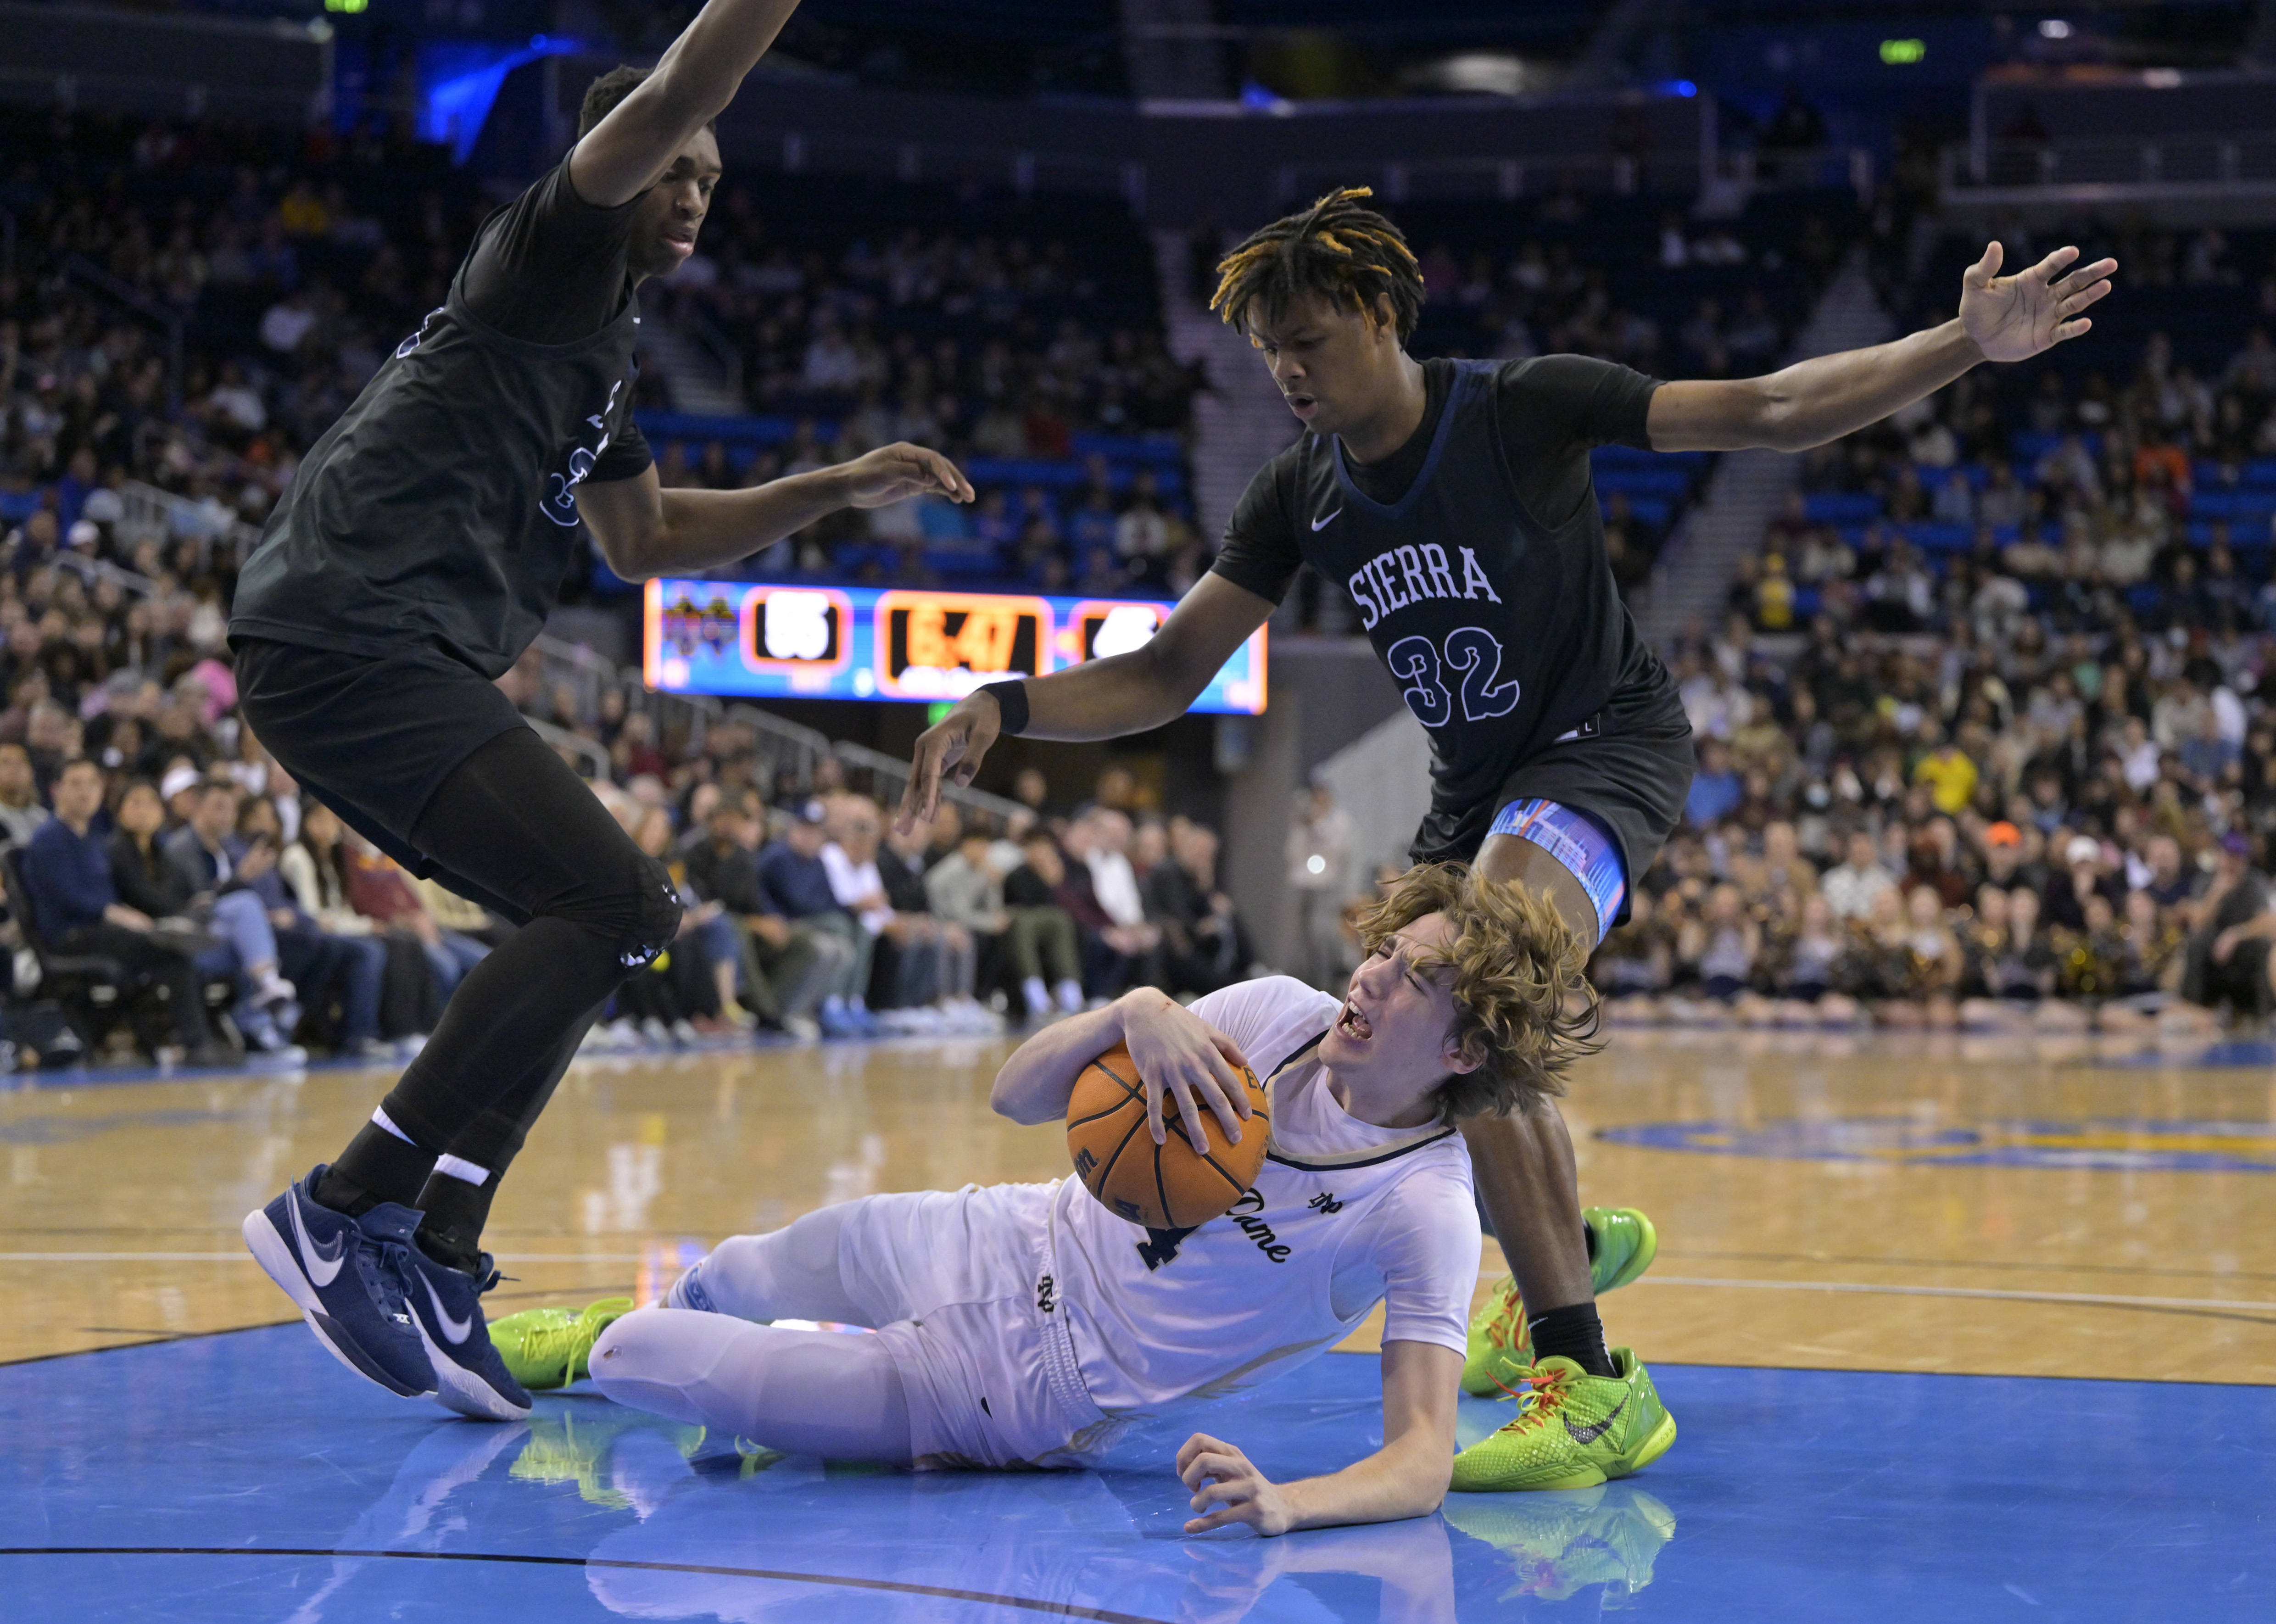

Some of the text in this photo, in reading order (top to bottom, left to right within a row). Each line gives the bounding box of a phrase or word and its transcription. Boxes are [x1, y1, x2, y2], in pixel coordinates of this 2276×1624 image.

[1348, 543, 1502, 632] SIERRA
[1387, 626, 1520, 728] 32
[1585, 722, 1592, 732] L
